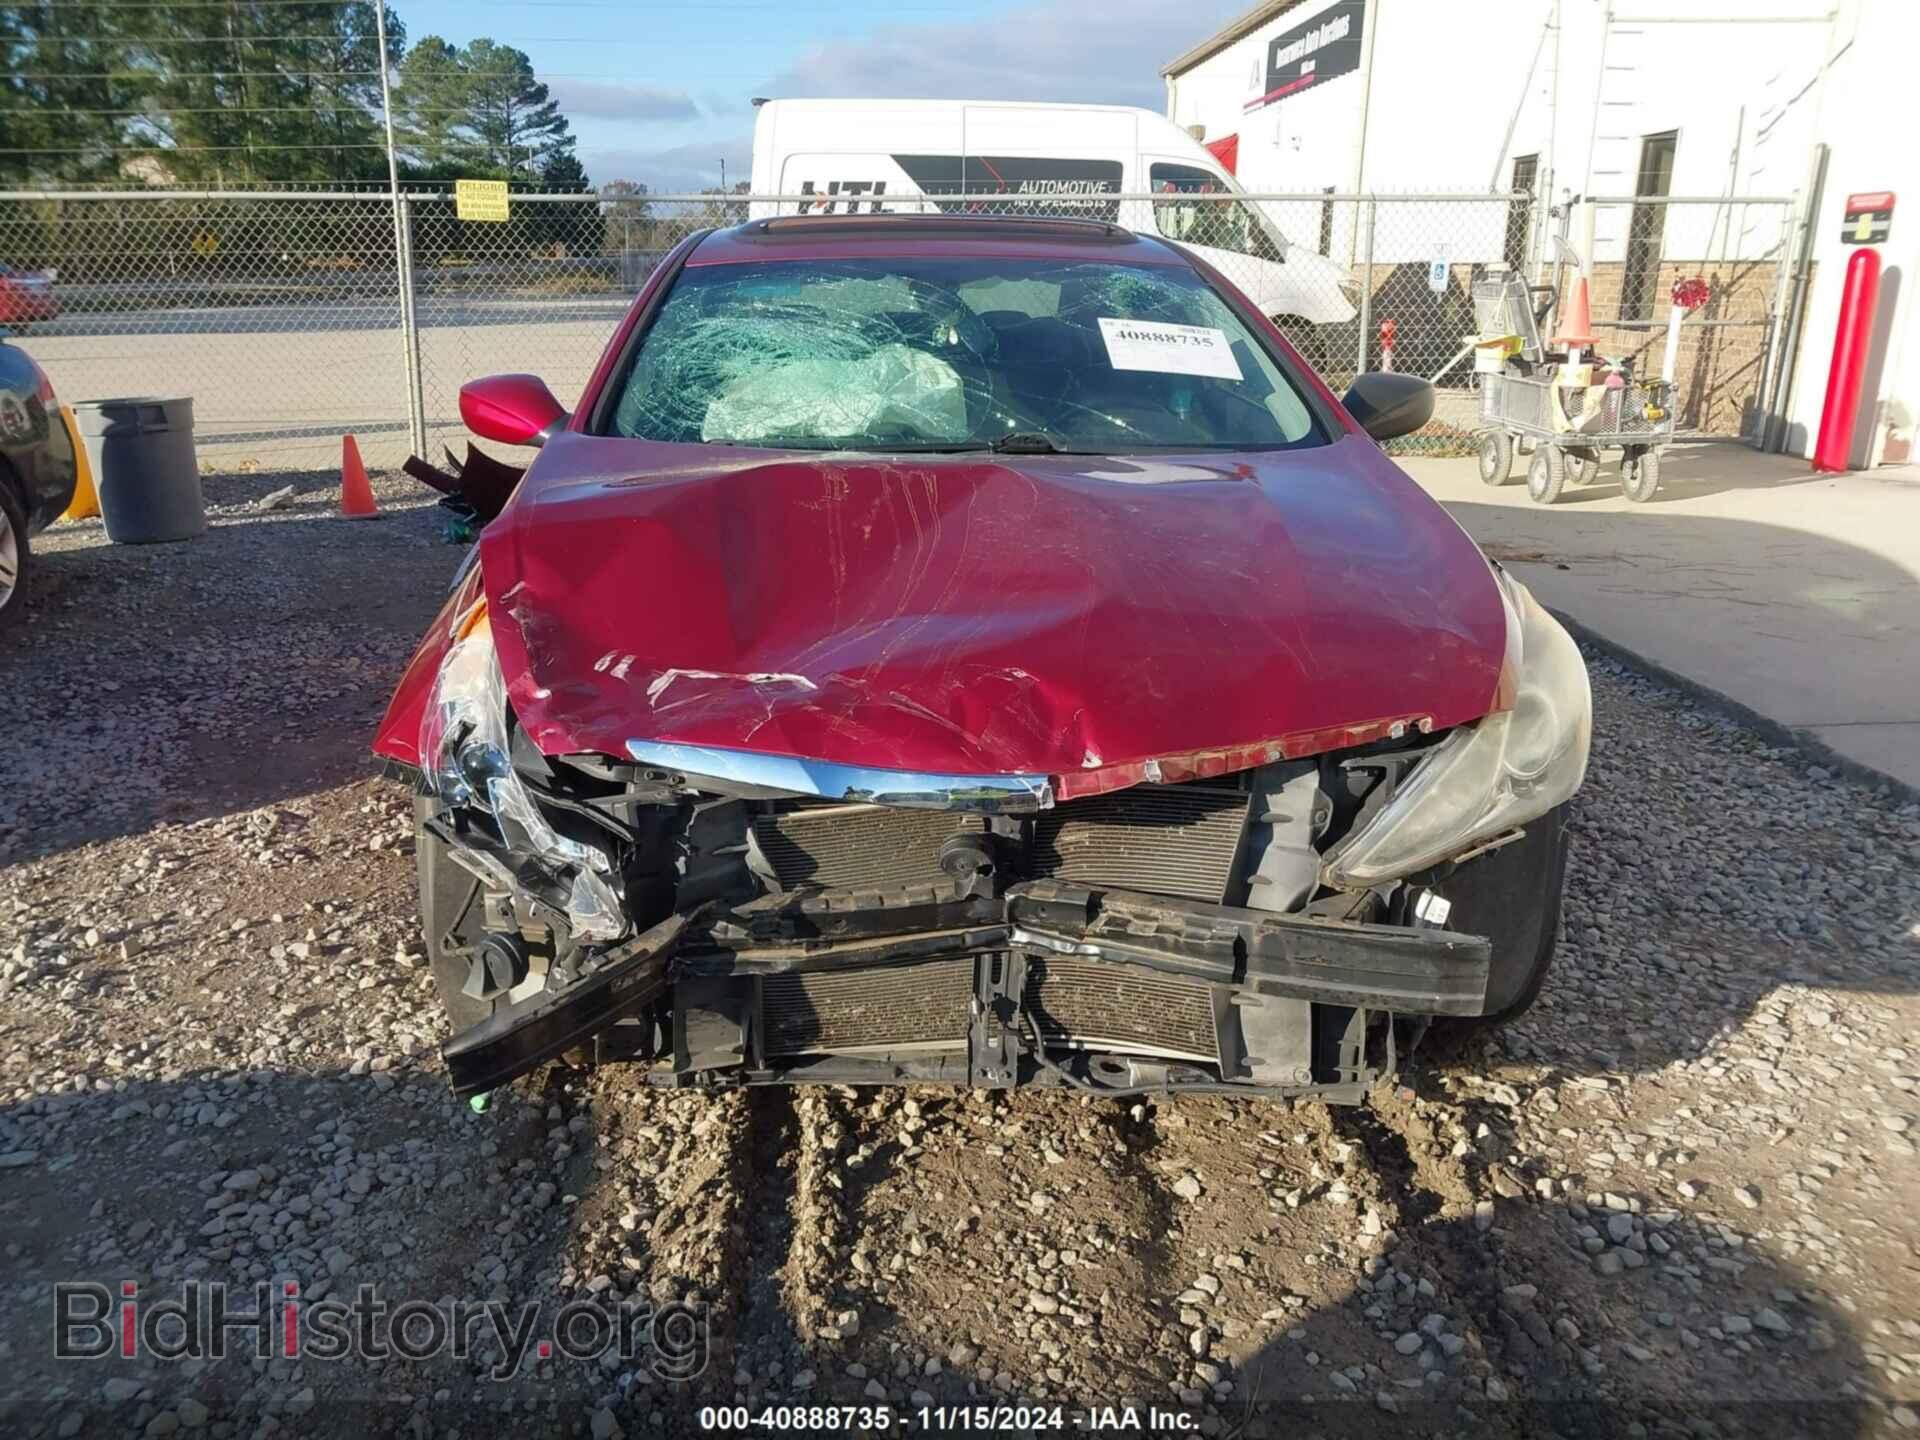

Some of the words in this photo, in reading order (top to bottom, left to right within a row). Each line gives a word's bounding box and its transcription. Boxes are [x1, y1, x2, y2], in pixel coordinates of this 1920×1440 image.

[459, 183, 505, 192] PELIGRO
[1018, 179, 1109, 195] AUTOMOTIVE
[1115, 330, 1215, 348] 40888735
